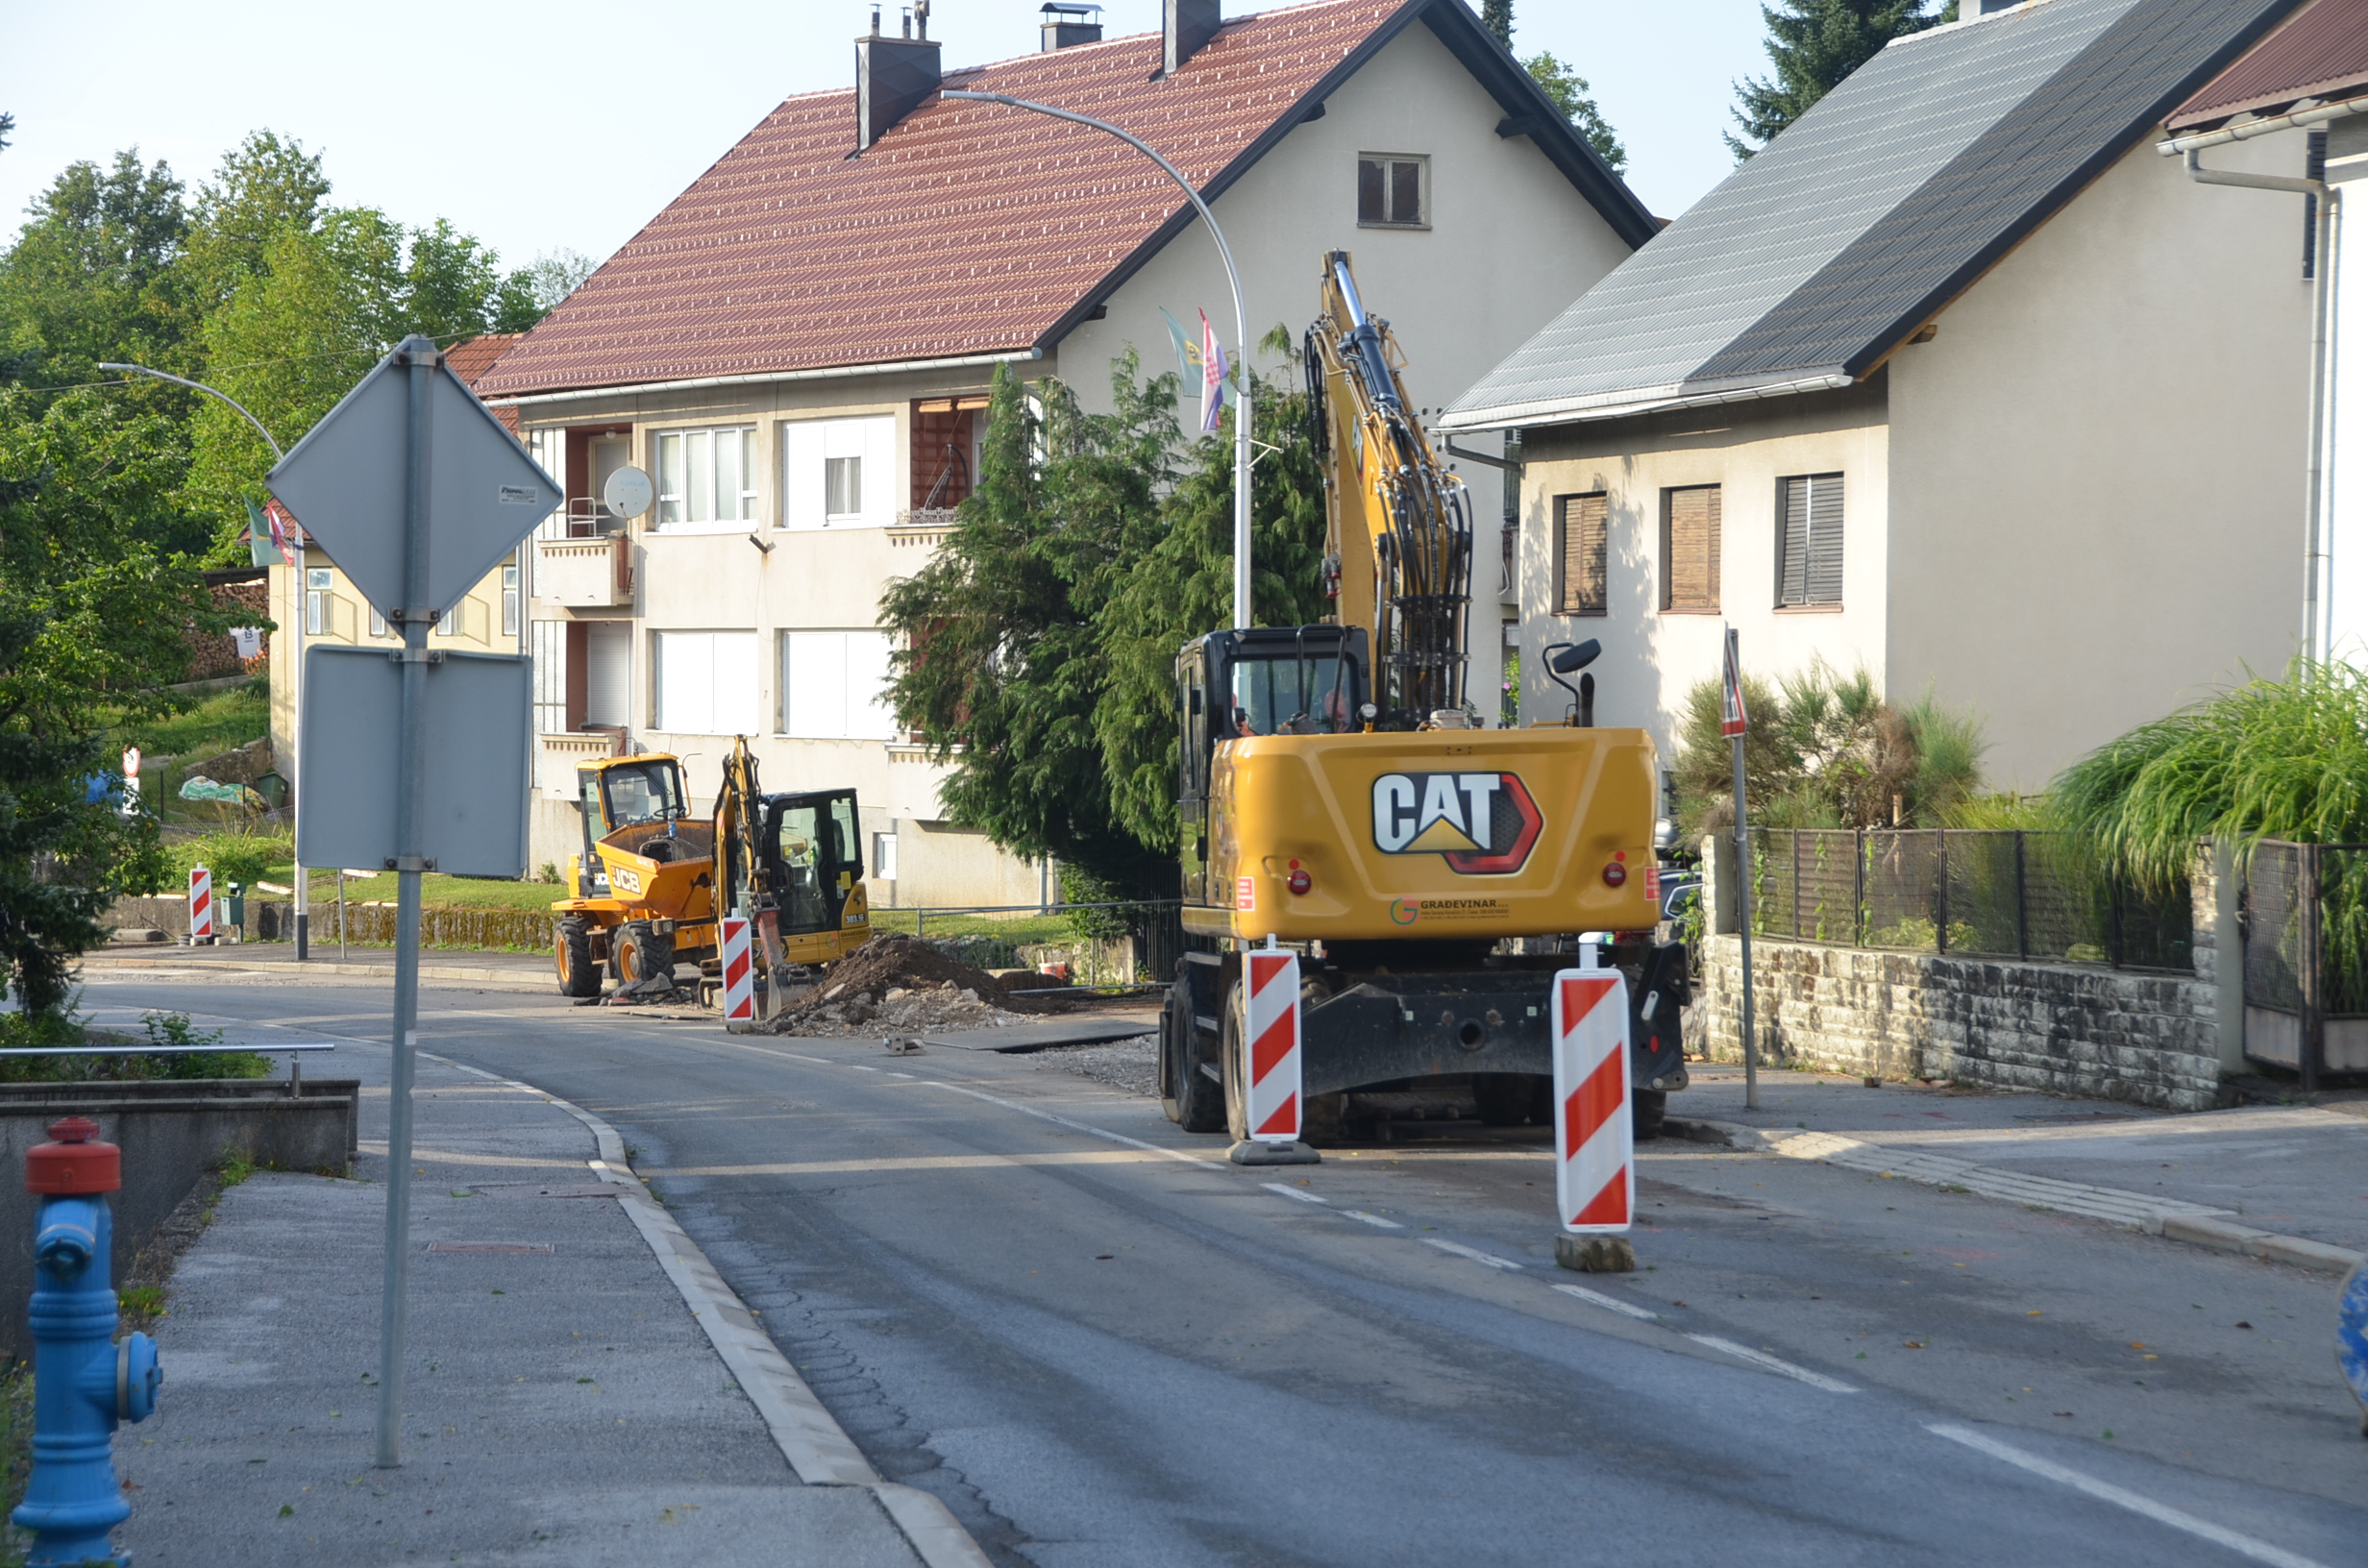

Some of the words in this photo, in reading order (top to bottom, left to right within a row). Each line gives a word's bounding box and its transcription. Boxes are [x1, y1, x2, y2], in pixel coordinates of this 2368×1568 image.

[1373, 773, 1500, 852] CAT
[612, 867, 641, 894] JCB
[1420, 899, 1497, 909] GRAĐEVINAR
